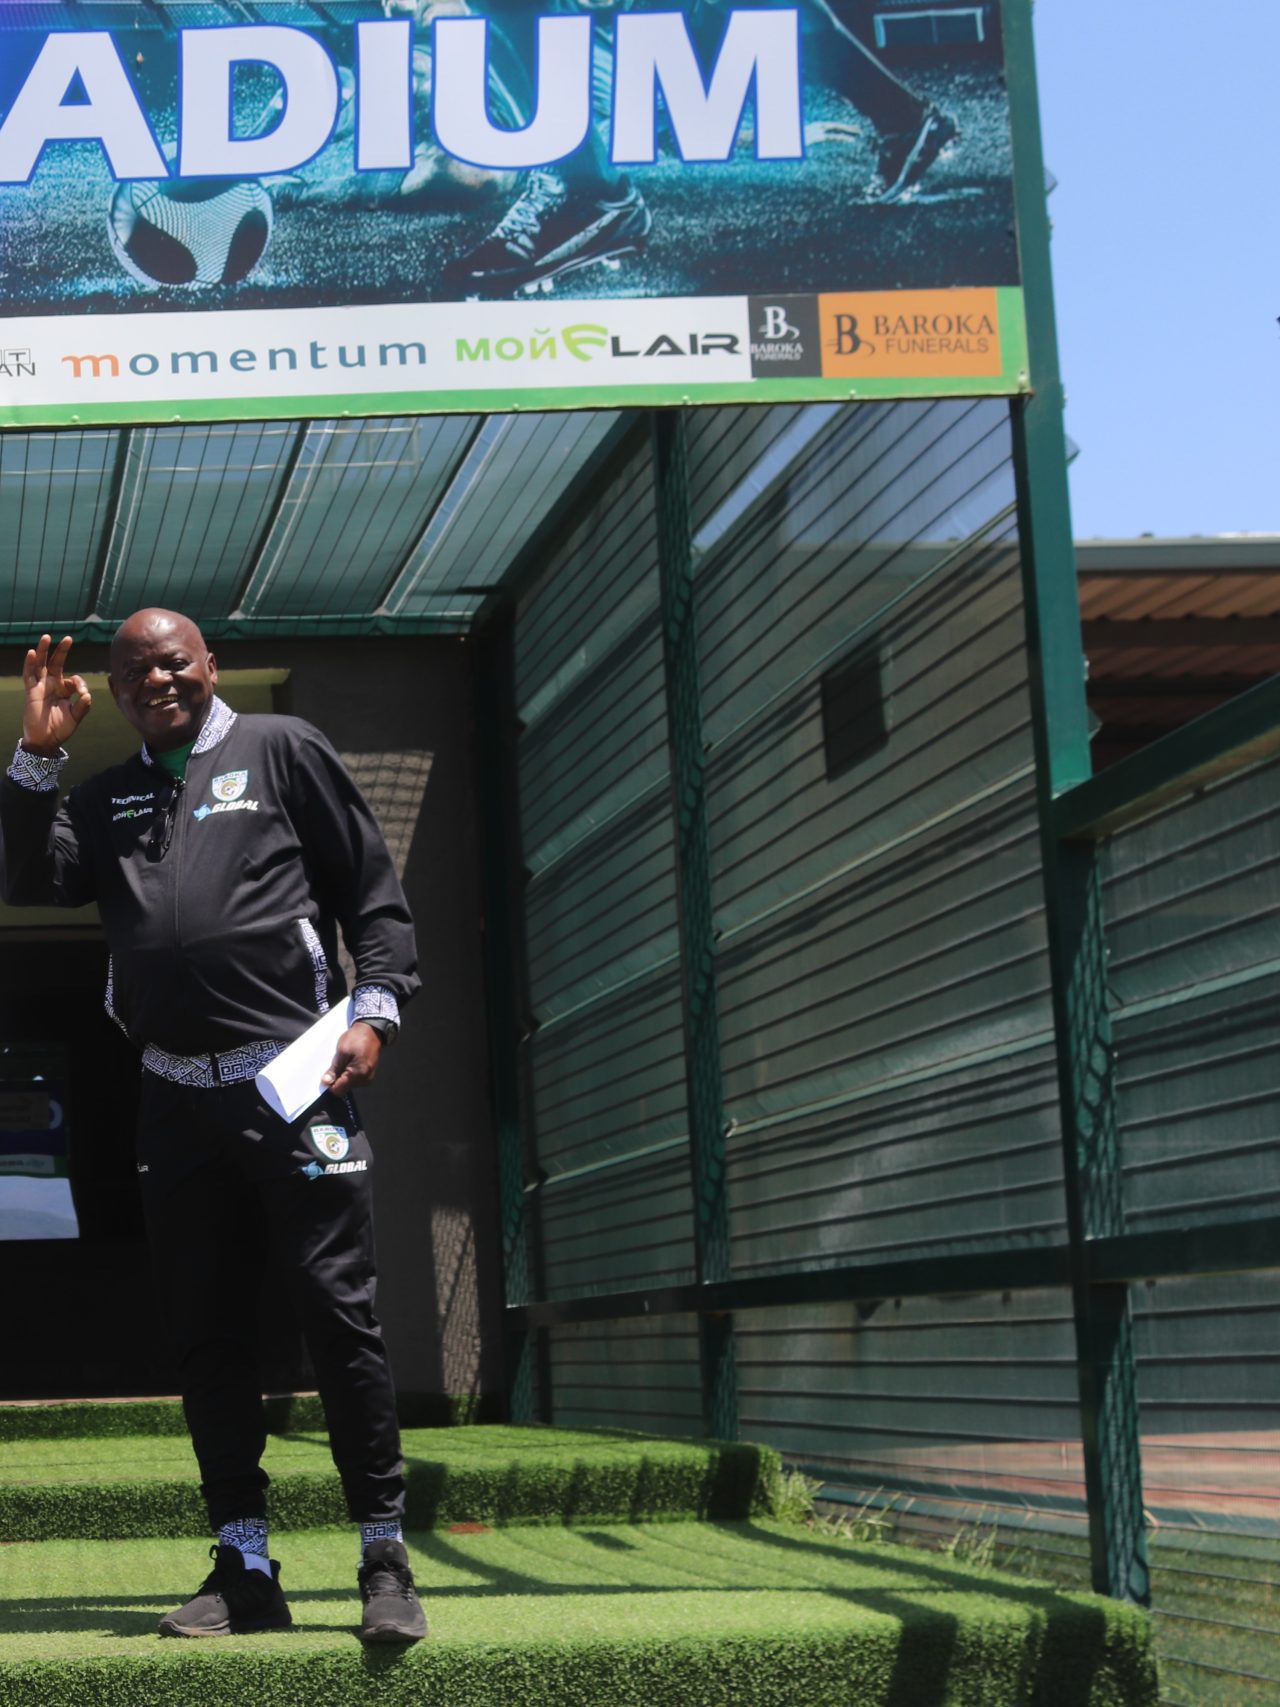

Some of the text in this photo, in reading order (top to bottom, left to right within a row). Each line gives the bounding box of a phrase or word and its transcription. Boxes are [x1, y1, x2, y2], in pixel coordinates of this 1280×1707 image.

[874, 314, 995, 336] BAROKA
[750, 343, 804, 354] BAROKA
[885, 337, 990, 354] FUNERALS
[61, 341, 427, 378] momentum
[754, 353, 801, 362] FUNERALS
[212, 800, 259, 813] GLOBAL
[324, 1160, 368, 1175] GLOBAL
